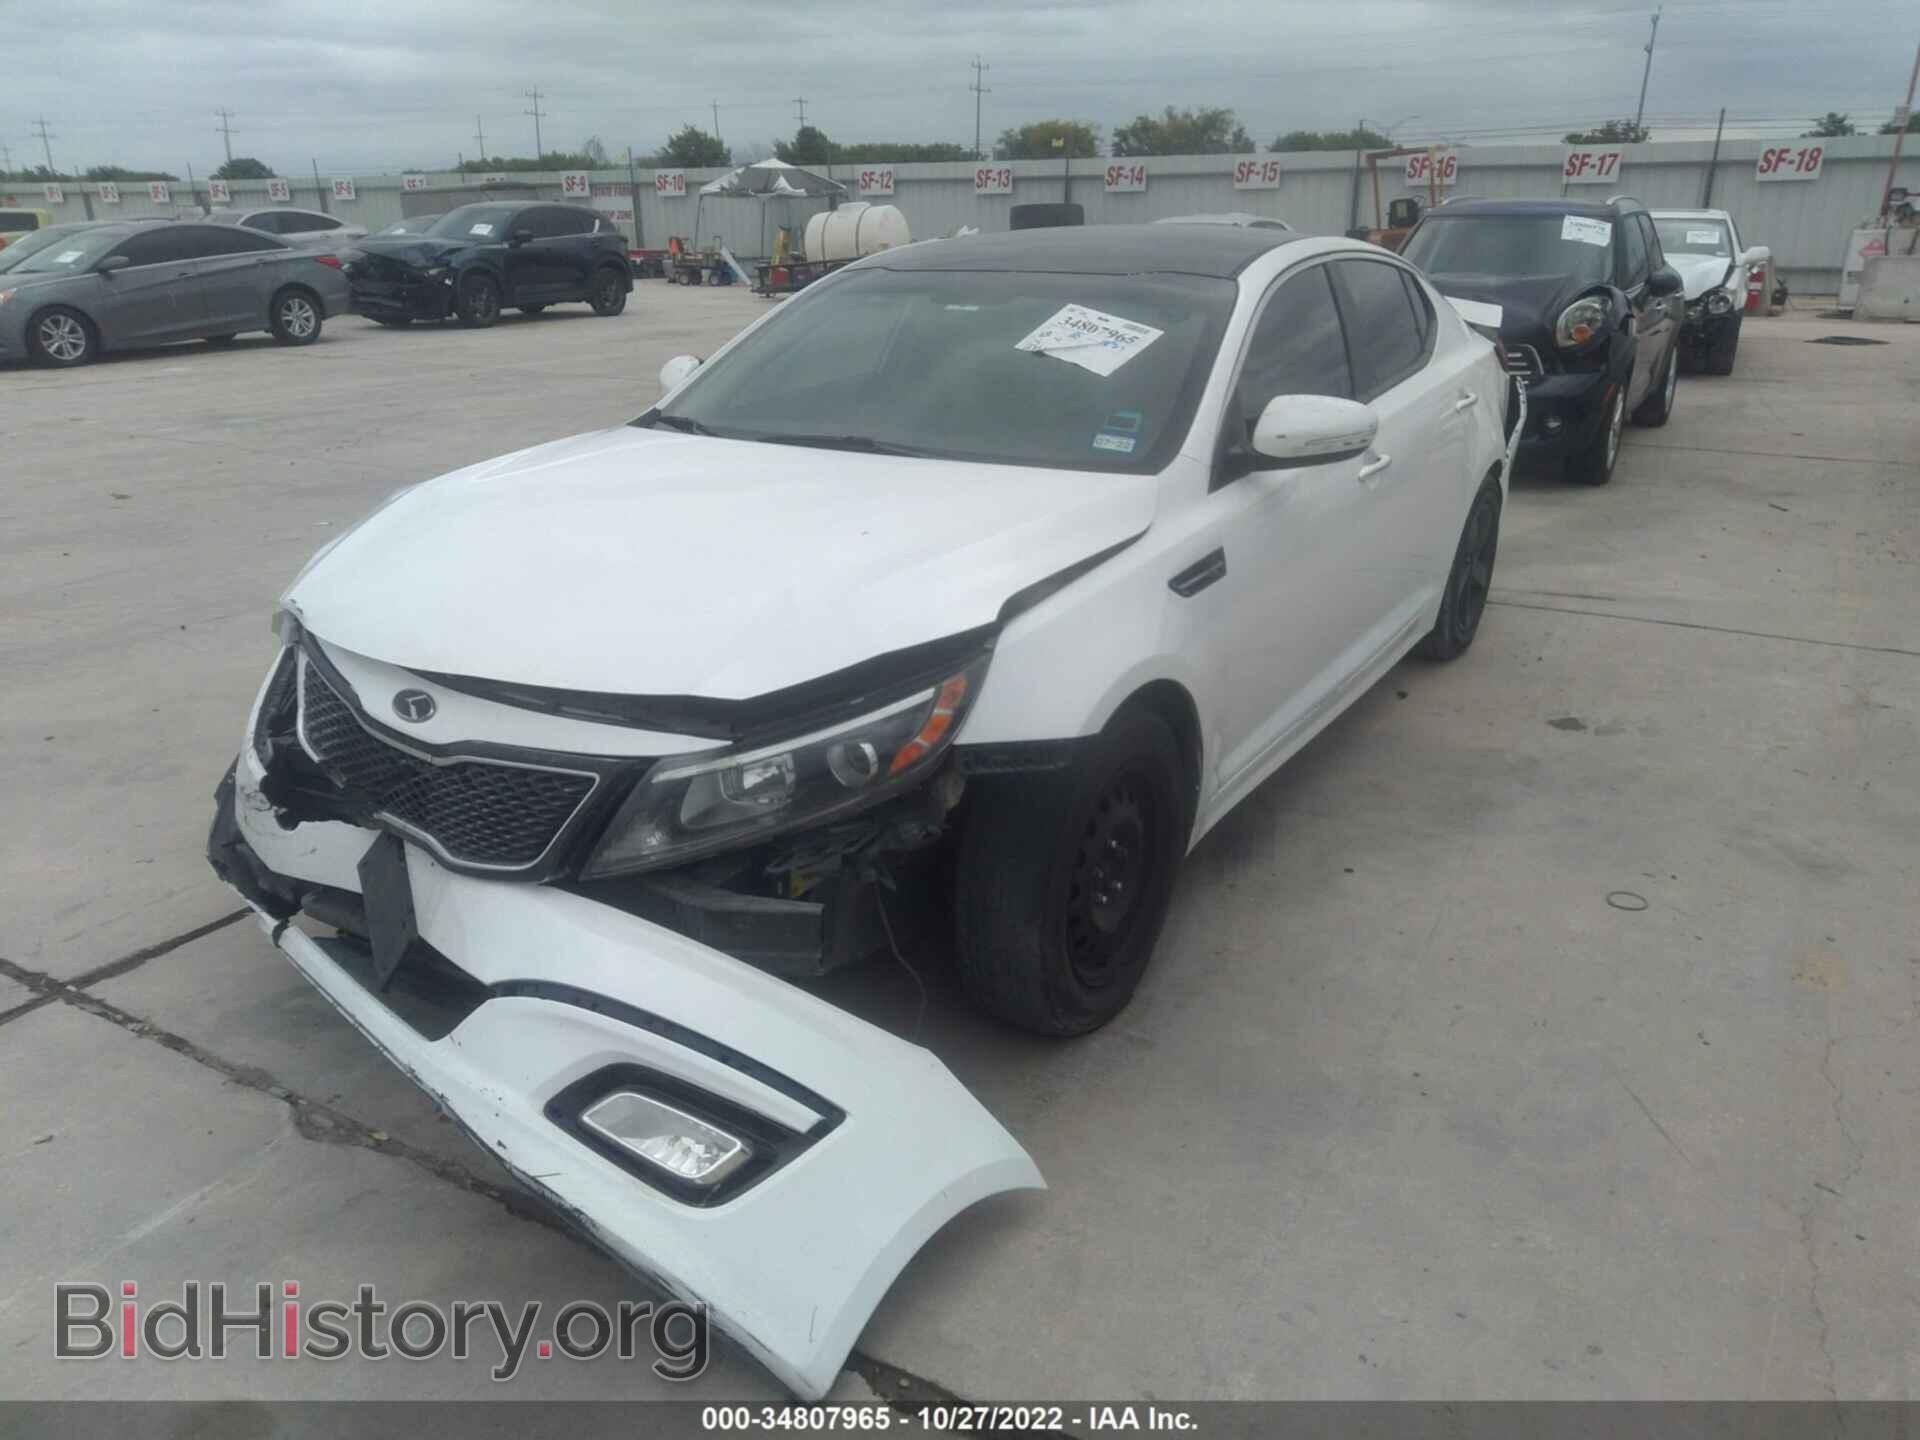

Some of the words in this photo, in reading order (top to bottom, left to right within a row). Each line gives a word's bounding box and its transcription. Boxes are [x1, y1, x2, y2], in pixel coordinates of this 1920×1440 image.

[1564, 153, 1620, 177] SF-17
[1758, 147, 1823, 174] SF-18
[656, 174, 685, 192] SF-10
[860, 167, 893, 191] SF-12
[975, 169, 1011, 188] SF-13
[1105, 165, 1145, 186] SF-14
[1234, 161, 1280, 183] SF-15
[565, 175, 586, 192] SF-9
[1057, 316, 1139, 345] 34807965
